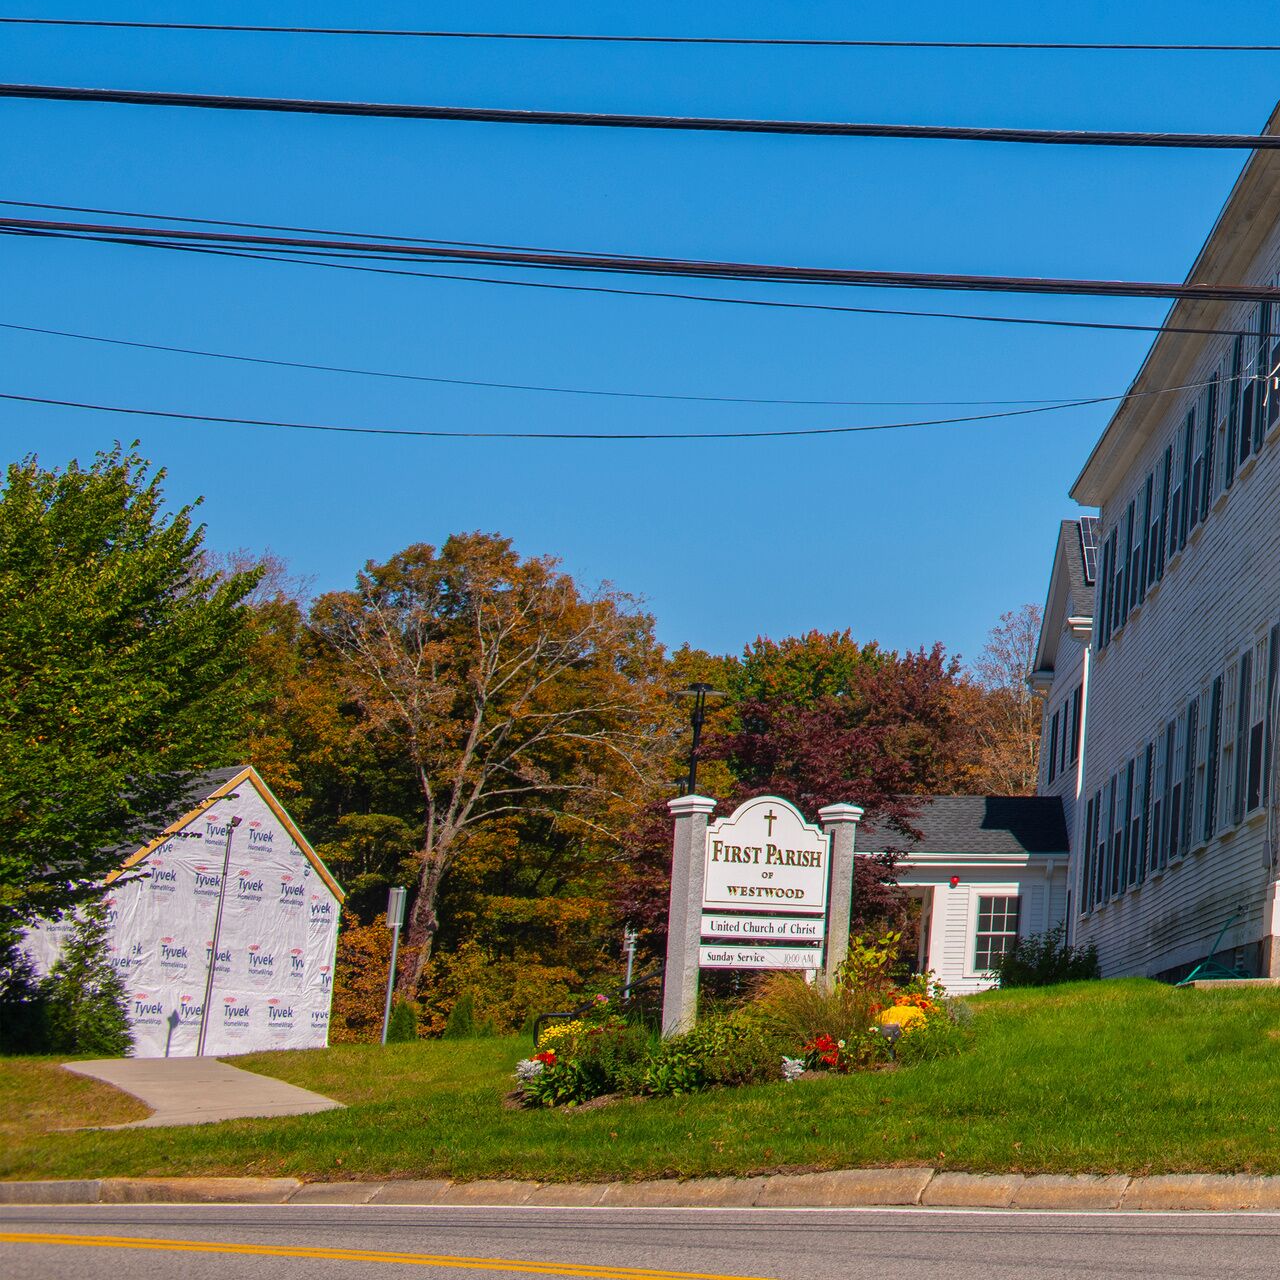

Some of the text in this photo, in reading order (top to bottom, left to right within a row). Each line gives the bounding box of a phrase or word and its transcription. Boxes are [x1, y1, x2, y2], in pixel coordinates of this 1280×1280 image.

[249, 829, 274, 843] Tyvek
[248, 844, 272, 853] HomeWrap
[712, 840, 822, 868] FIRST PARISH
[151, 867, 176, 882] Tyvek
[195, 873, 221, 887] Tyvek
[761, 871, 773, 879] OF
[239, 878, 264, 893] Tyvek
[281, 883, 305, 897] Tyvek
[727, 885, 805, 899] WESTWOOD
[311, 903, 331, 916] yvek
[711, 920, 816, 935] United Church of Christ
[161, 945, 188, 959] Tyvek
[706, 951, 814, 965] Sunday Service 10:00 AM
[249, 952, 274, 967] Tyvek
[135, 1001, 163, 1017] Tyvek
[224, 1005, 250, 1019] Tyvek
[268, 1006, 293, 1020] Tyvek
